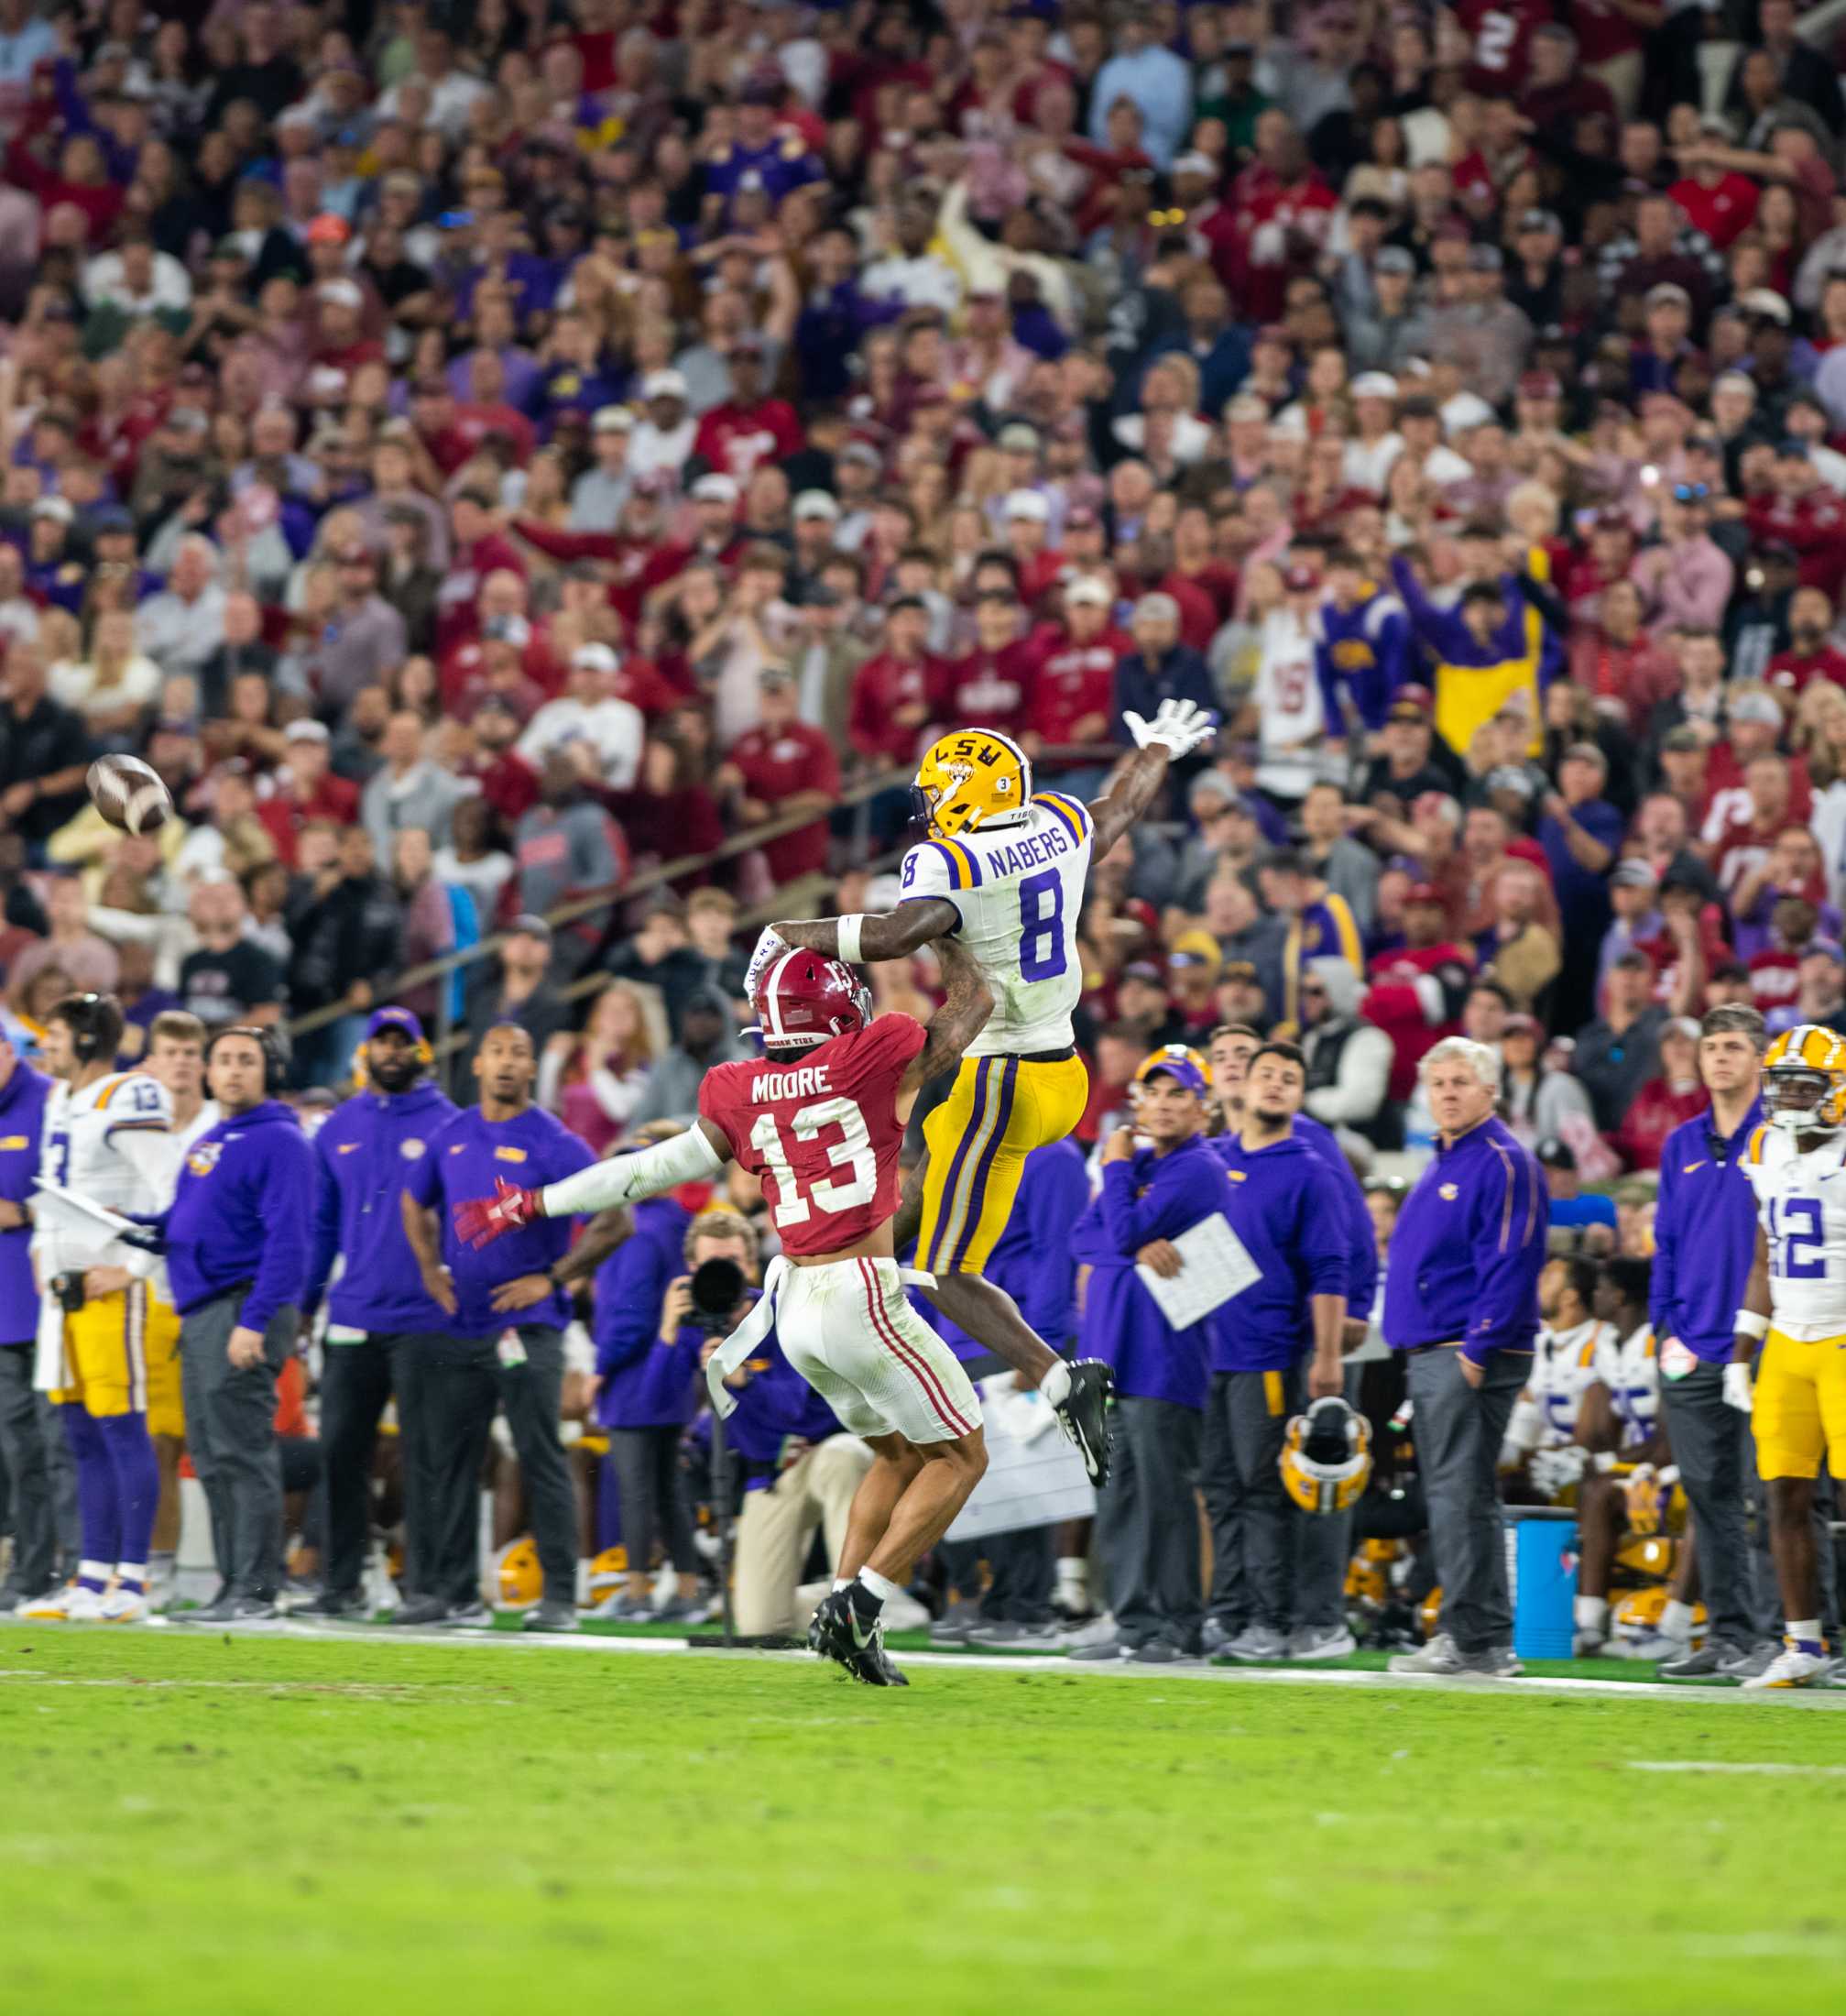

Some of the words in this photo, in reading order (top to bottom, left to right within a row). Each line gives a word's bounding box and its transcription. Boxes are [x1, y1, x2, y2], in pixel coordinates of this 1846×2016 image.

[1480, 10, 1517, 70] 2
[934, 740, 1001, 767] LSU
[901, 852, 920, 889] 8
[987, 827, 1067, 879] NABERS
[1019, 867, 1067, 983] 8
[823, 959, 853, 992] 13
[792, 1036, 814, 1045] TIDE
[134, 1083, 161, 1112] 13
[751, 1065, 833, 1103] MOORE
[749, 1097, 878, 1228] 13
